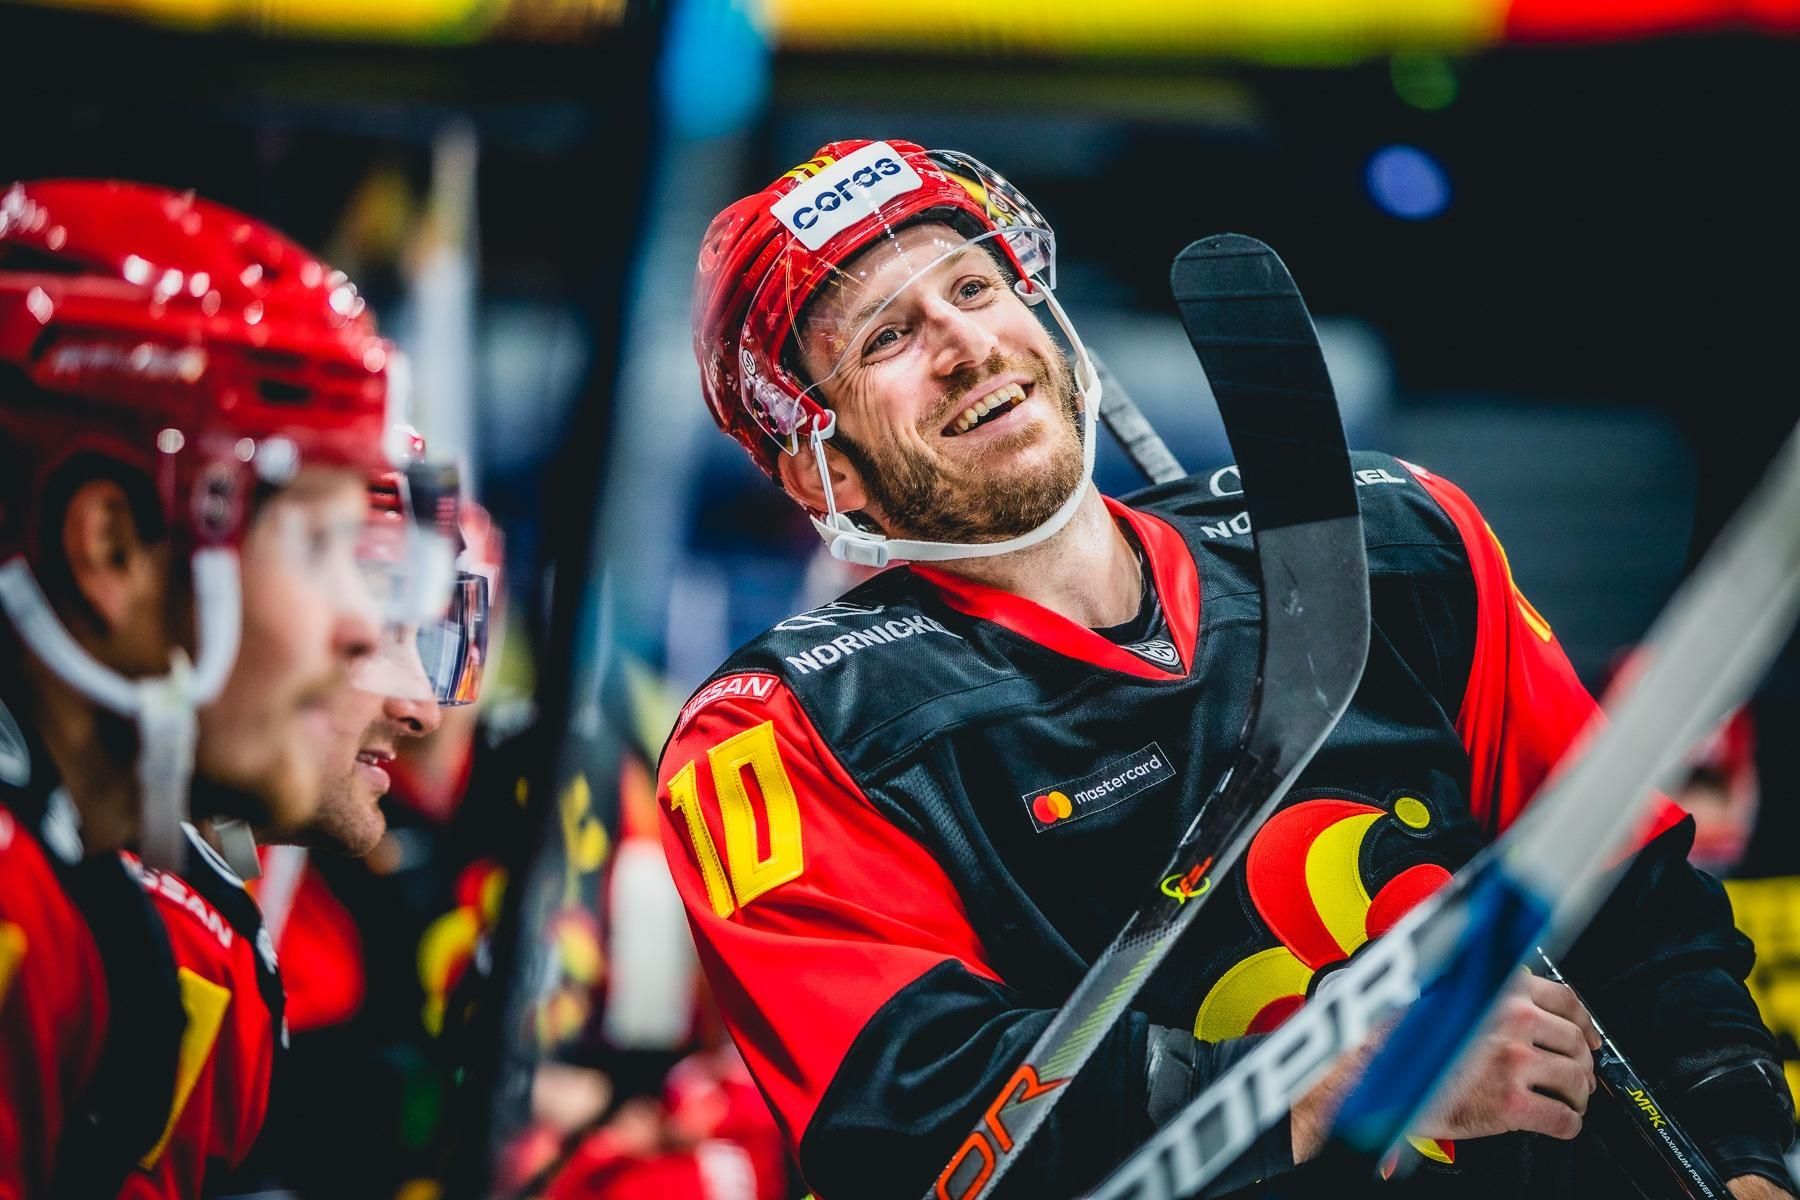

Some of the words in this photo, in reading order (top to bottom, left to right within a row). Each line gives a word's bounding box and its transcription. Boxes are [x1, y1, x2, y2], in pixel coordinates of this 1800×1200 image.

[793, 158, 901, 229] coras
[785, 615, 963, 674] NORNICK
[679, 676, 775, 730] NISSAN
[1074, 755, 1162, 804] mastercard
[667, 720, 804, 919] 10
[1625, 1085, 1666, 1128] MPK
[1658, 1128, 1692, 1169] MAXIMUM
[1688, 1169, 1714, 1198] POWER
